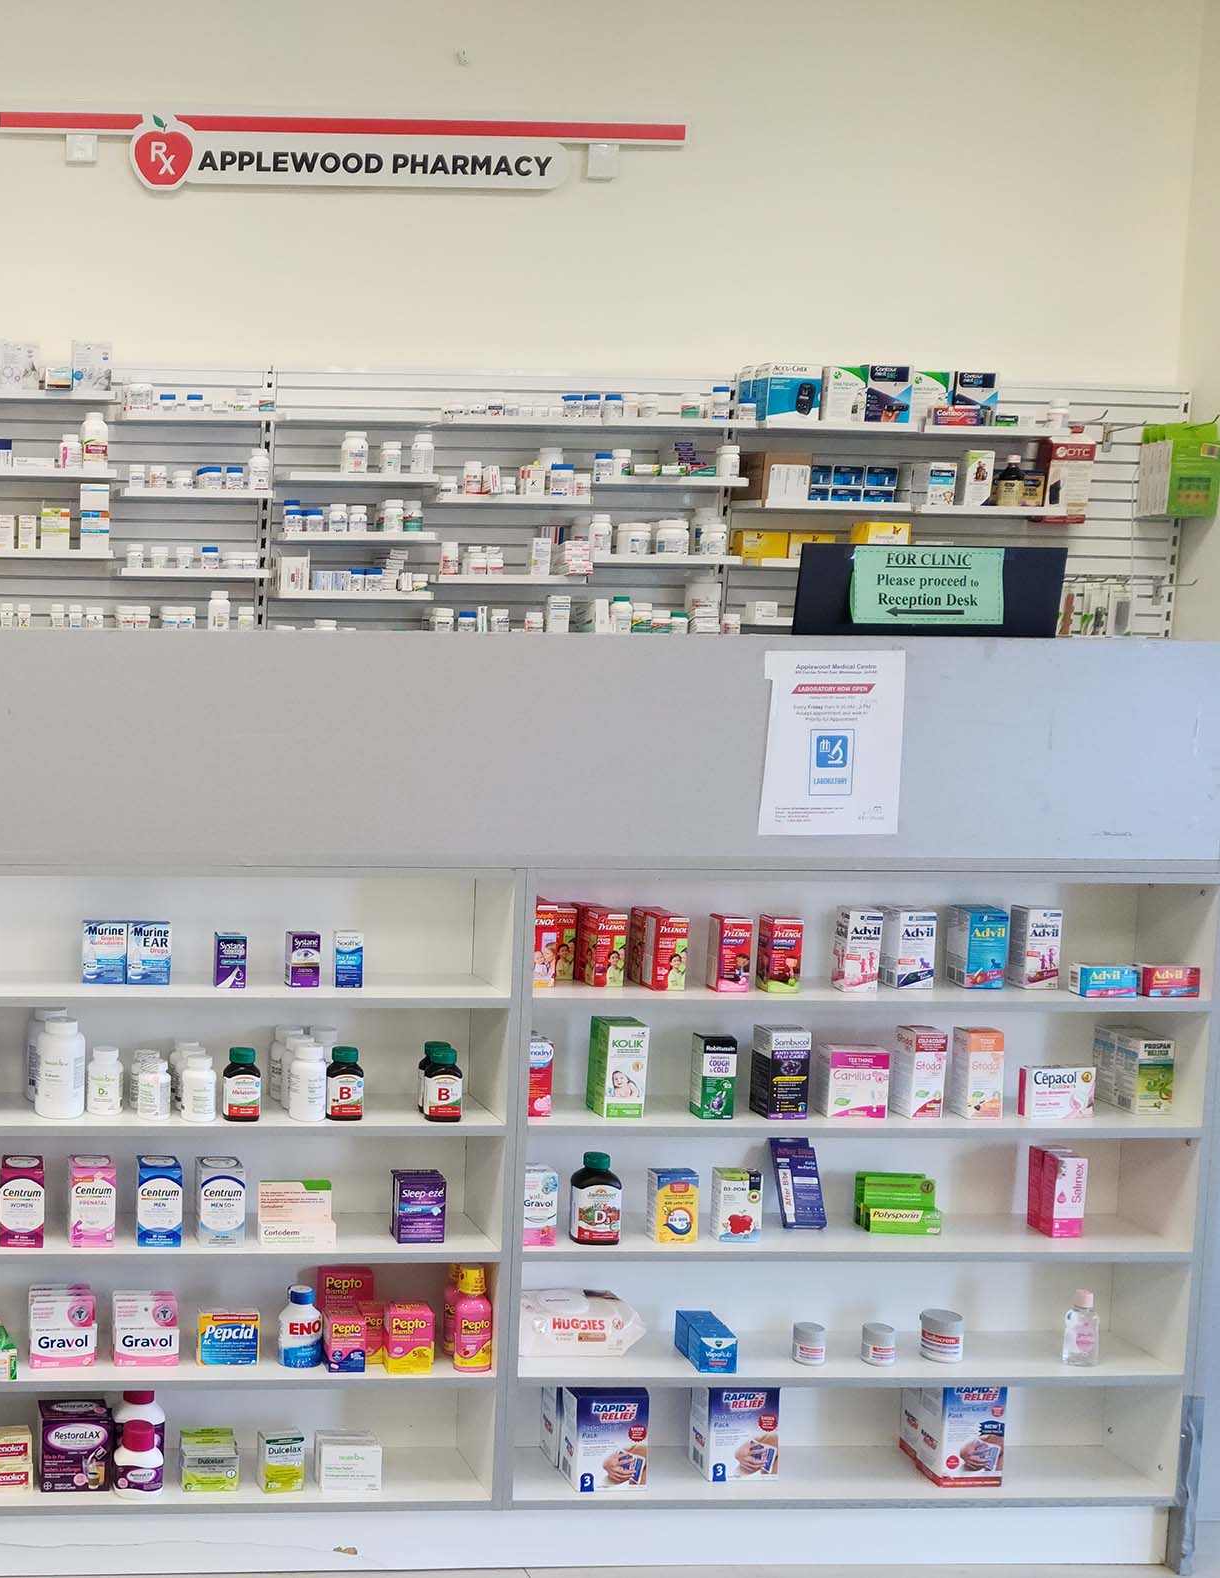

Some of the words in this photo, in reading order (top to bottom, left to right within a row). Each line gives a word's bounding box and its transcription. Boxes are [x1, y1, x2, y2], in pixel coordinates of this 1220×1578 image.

[198, 151, 383, 174] APPLEWOOD
[392, 154, 553, 177] PHARMACY
[886, 553, 917, 565] FOR
[921, 553, 973, 566] CLINIC
[877, 573, 916, 586] Please
[919, 575, 966, 590] proceed
[971, 579, 979, 587] to
[878, 593, 942, 608] Reception
[946, 594, 979, 607] Desk
[795, 663, 831, 671] Applewood
[88, 926, 124, 936] Murine
[133, 927, 170, 938] Murine
[598, 923, 625, 931] TYLENOL
[659, 925, 687, 933] TYLENOL
[850, 926, 881, 936] Advil
[902, 927, 934, 938] Advil
[972, 927, 1005, 938] Advil
[773, 930, 802, 938] TYLENOL
[1030, 928, 1059, 938] Advil
[143, 938, 168, 948] EAR
[219, 941, 245, 952] Systane
[294, 937, 319, 949] Systane
[149, 947, 169, 955] Drops
[1090, 970, 1121, 980] Advil
[1153, 969, 1183, 979] Advil
[611, 1039, 643, 1049] KOLIK
[774, 1038, 811, 1047] Sambucol
[833, 1069, 871, 1081] Camilia
[1071, 1163, 1084, 1204] Salinex
[3, 1188, 42, 1198] Centrum
[75, 1186, 113, 1197] Centrum
[141, 1187, 180, 1198] Centrum
[203, 1187, 243, 1198] Centrum
[523, 1199, 554, 1208] Gravol
[872, 1210, 919, 1221] Polysporin
[264, 1229, 300, 1237] Cortoderm
[325, 1276, 363, 1290] Pepto
[289, 1319, 322, 1336] ENO
[461, 1319, 490, 1331] Pepto
[552, 1317, 605, 1331] HUGGIES
[204, 1324, 255, 1342] Pepcid
[38, 1334, 89, 1350] Gravol
[122, 1335, 173, 1349] Gravol
[724, 1392, 756, 1401] RAPID
[964, 1393, 998, 1401] RELIEF
[593, 1403, 627, 1413] RAPID
[731, 1400, 765, 1409] RELIEF
[601, 1411, 637, 1421] RELIEF
[54, 1430, 101, 1441] RestoraLAX
[268, 1446, 302, 1455] Dulcolax
[197, 1457, 225, 1465] Dulcolax
[715, 1465, 723, 1476] 3
[583, 1474, 591, 1487] 3
